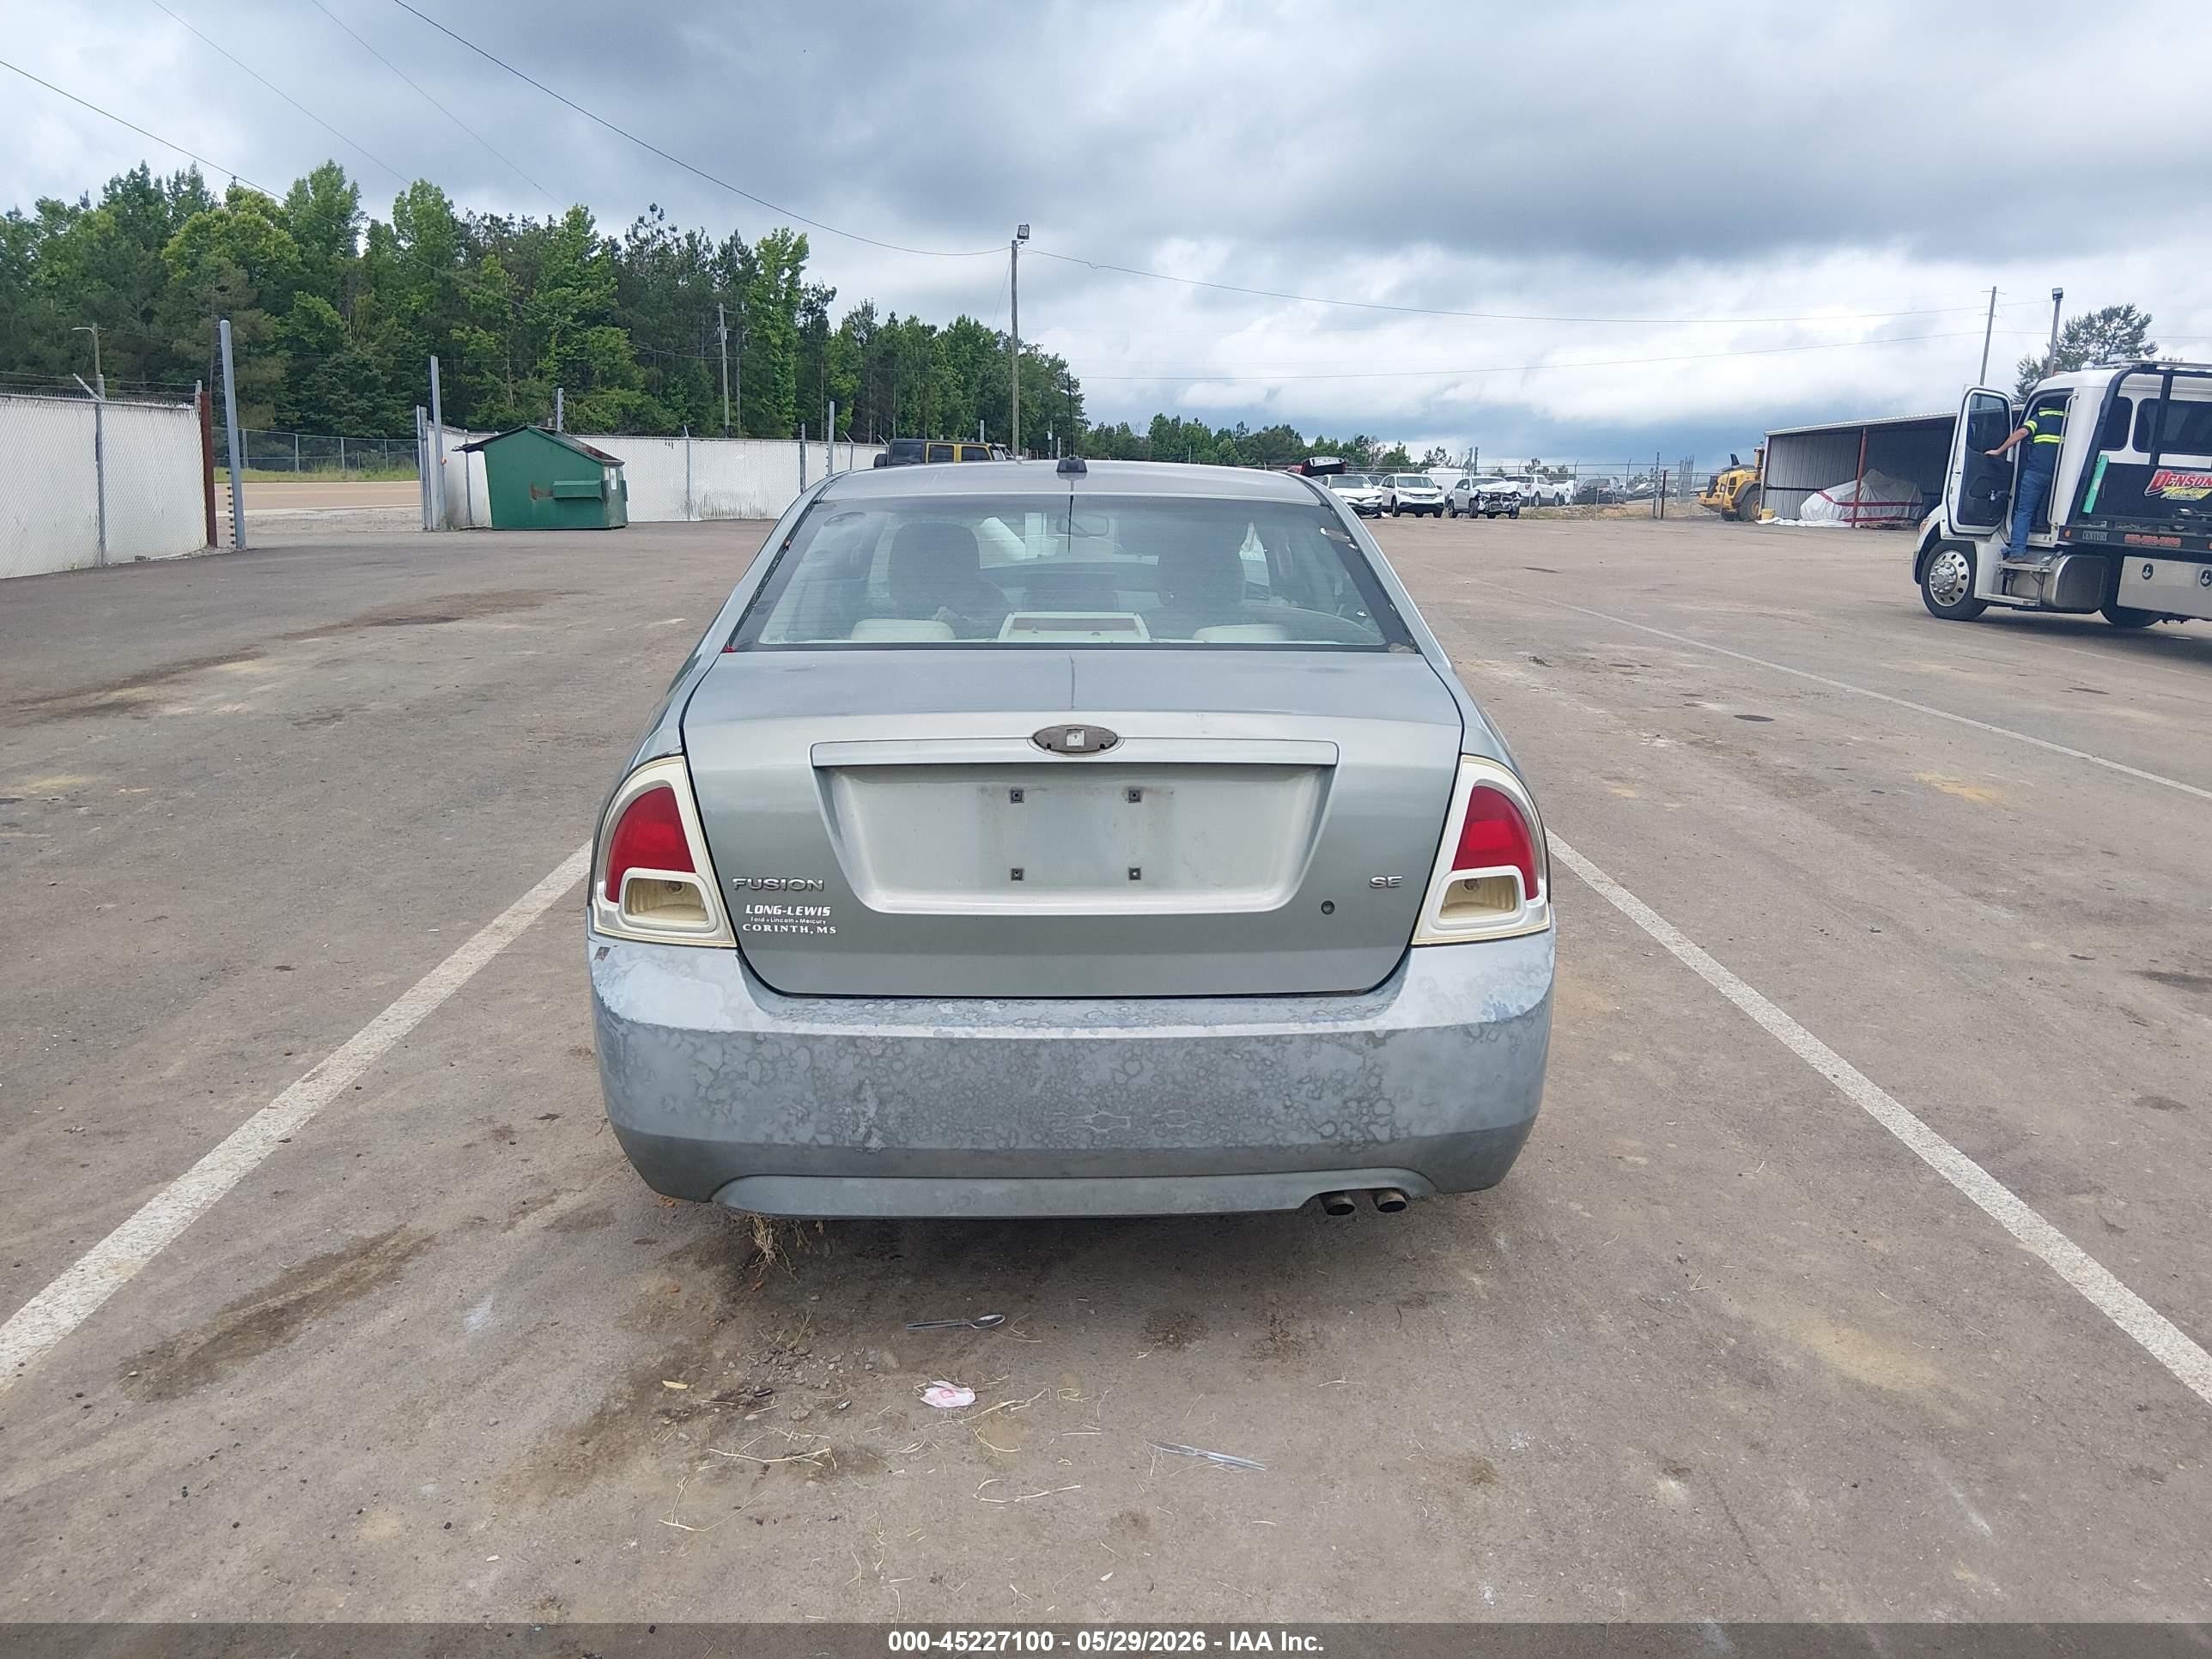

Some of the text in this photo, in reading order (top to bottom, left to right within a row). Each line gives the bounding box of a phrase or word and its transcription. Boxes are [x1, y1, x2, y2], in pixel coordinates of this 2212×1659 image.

[2081, 530, 2109, 542] CENTURY
[732, 878, 824, 891] FUSION
[1369, 876, 1402, 889] SE
[745, 904, 831, 916] LONG-LEWIS
[742, 923, 837, 935] CORINTH, MS
